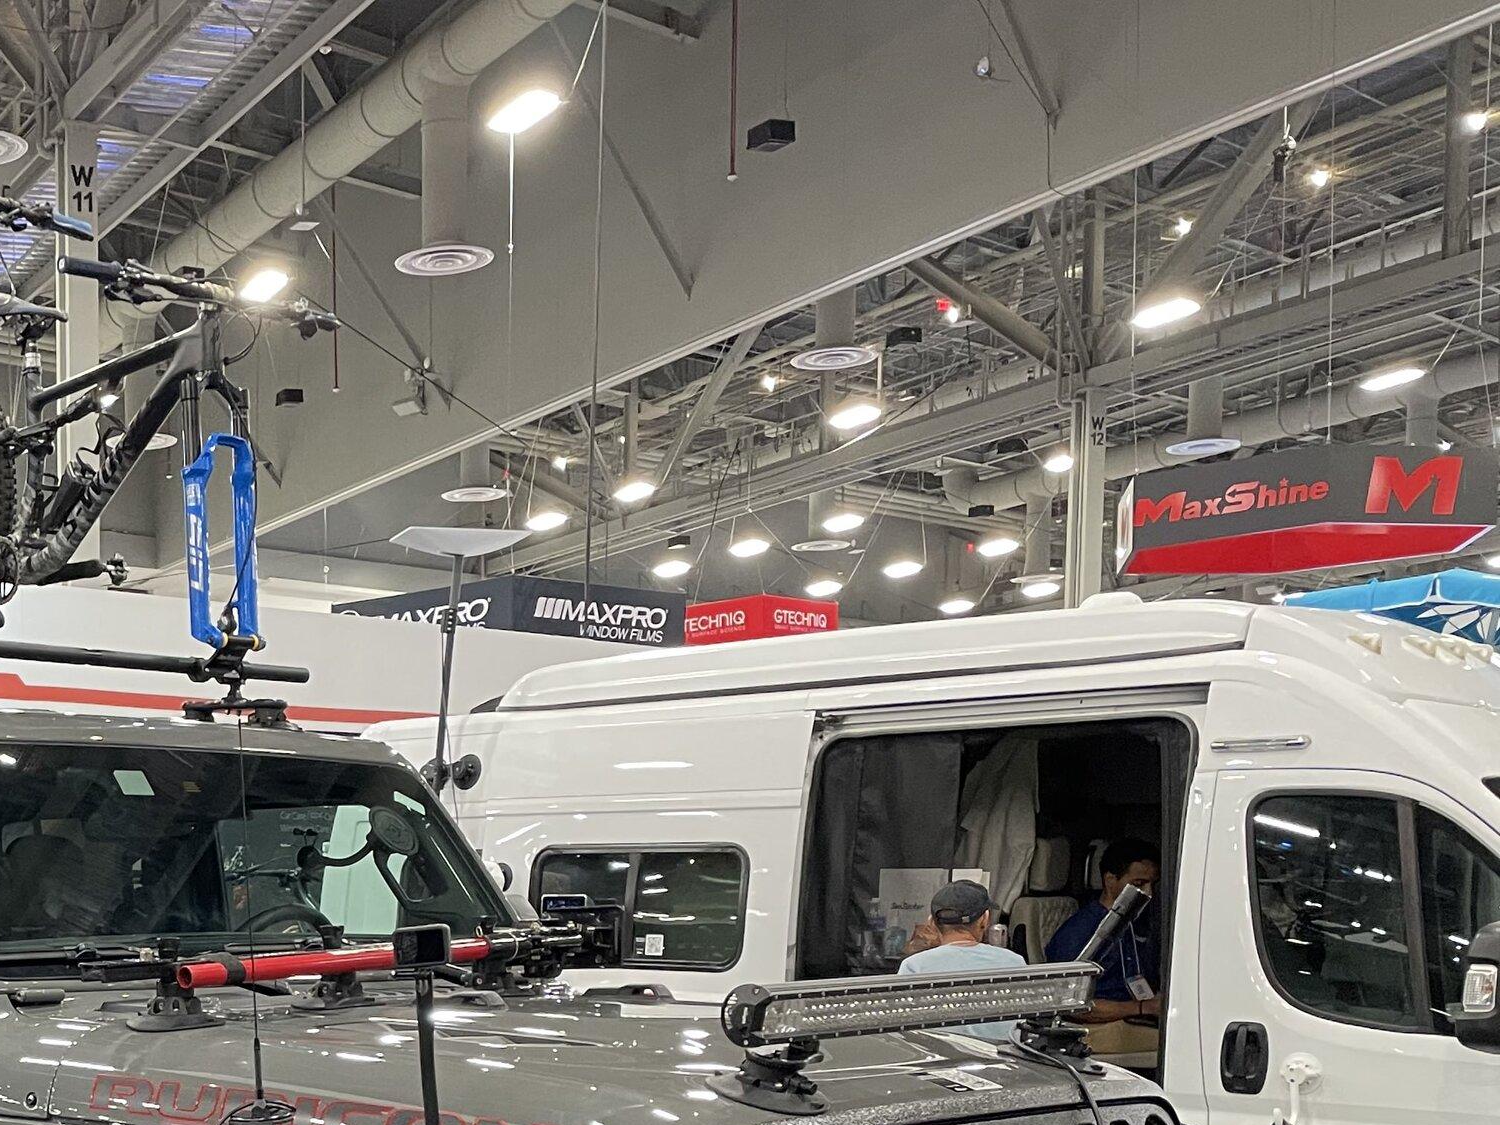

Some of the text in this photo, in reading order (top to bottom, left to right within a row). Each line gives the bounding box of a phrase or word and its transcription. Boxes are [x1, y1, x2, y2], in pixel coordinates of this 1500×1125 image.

[70, 164, 95, 188] W
[72, 191, 93, 212] 11
[1091, 416, 1104, 431] W
[1091, 433, 1104, 446] 12
[560, 599, 668, 629] MAXPRO
[629, 628, 663, 643] FILMS
